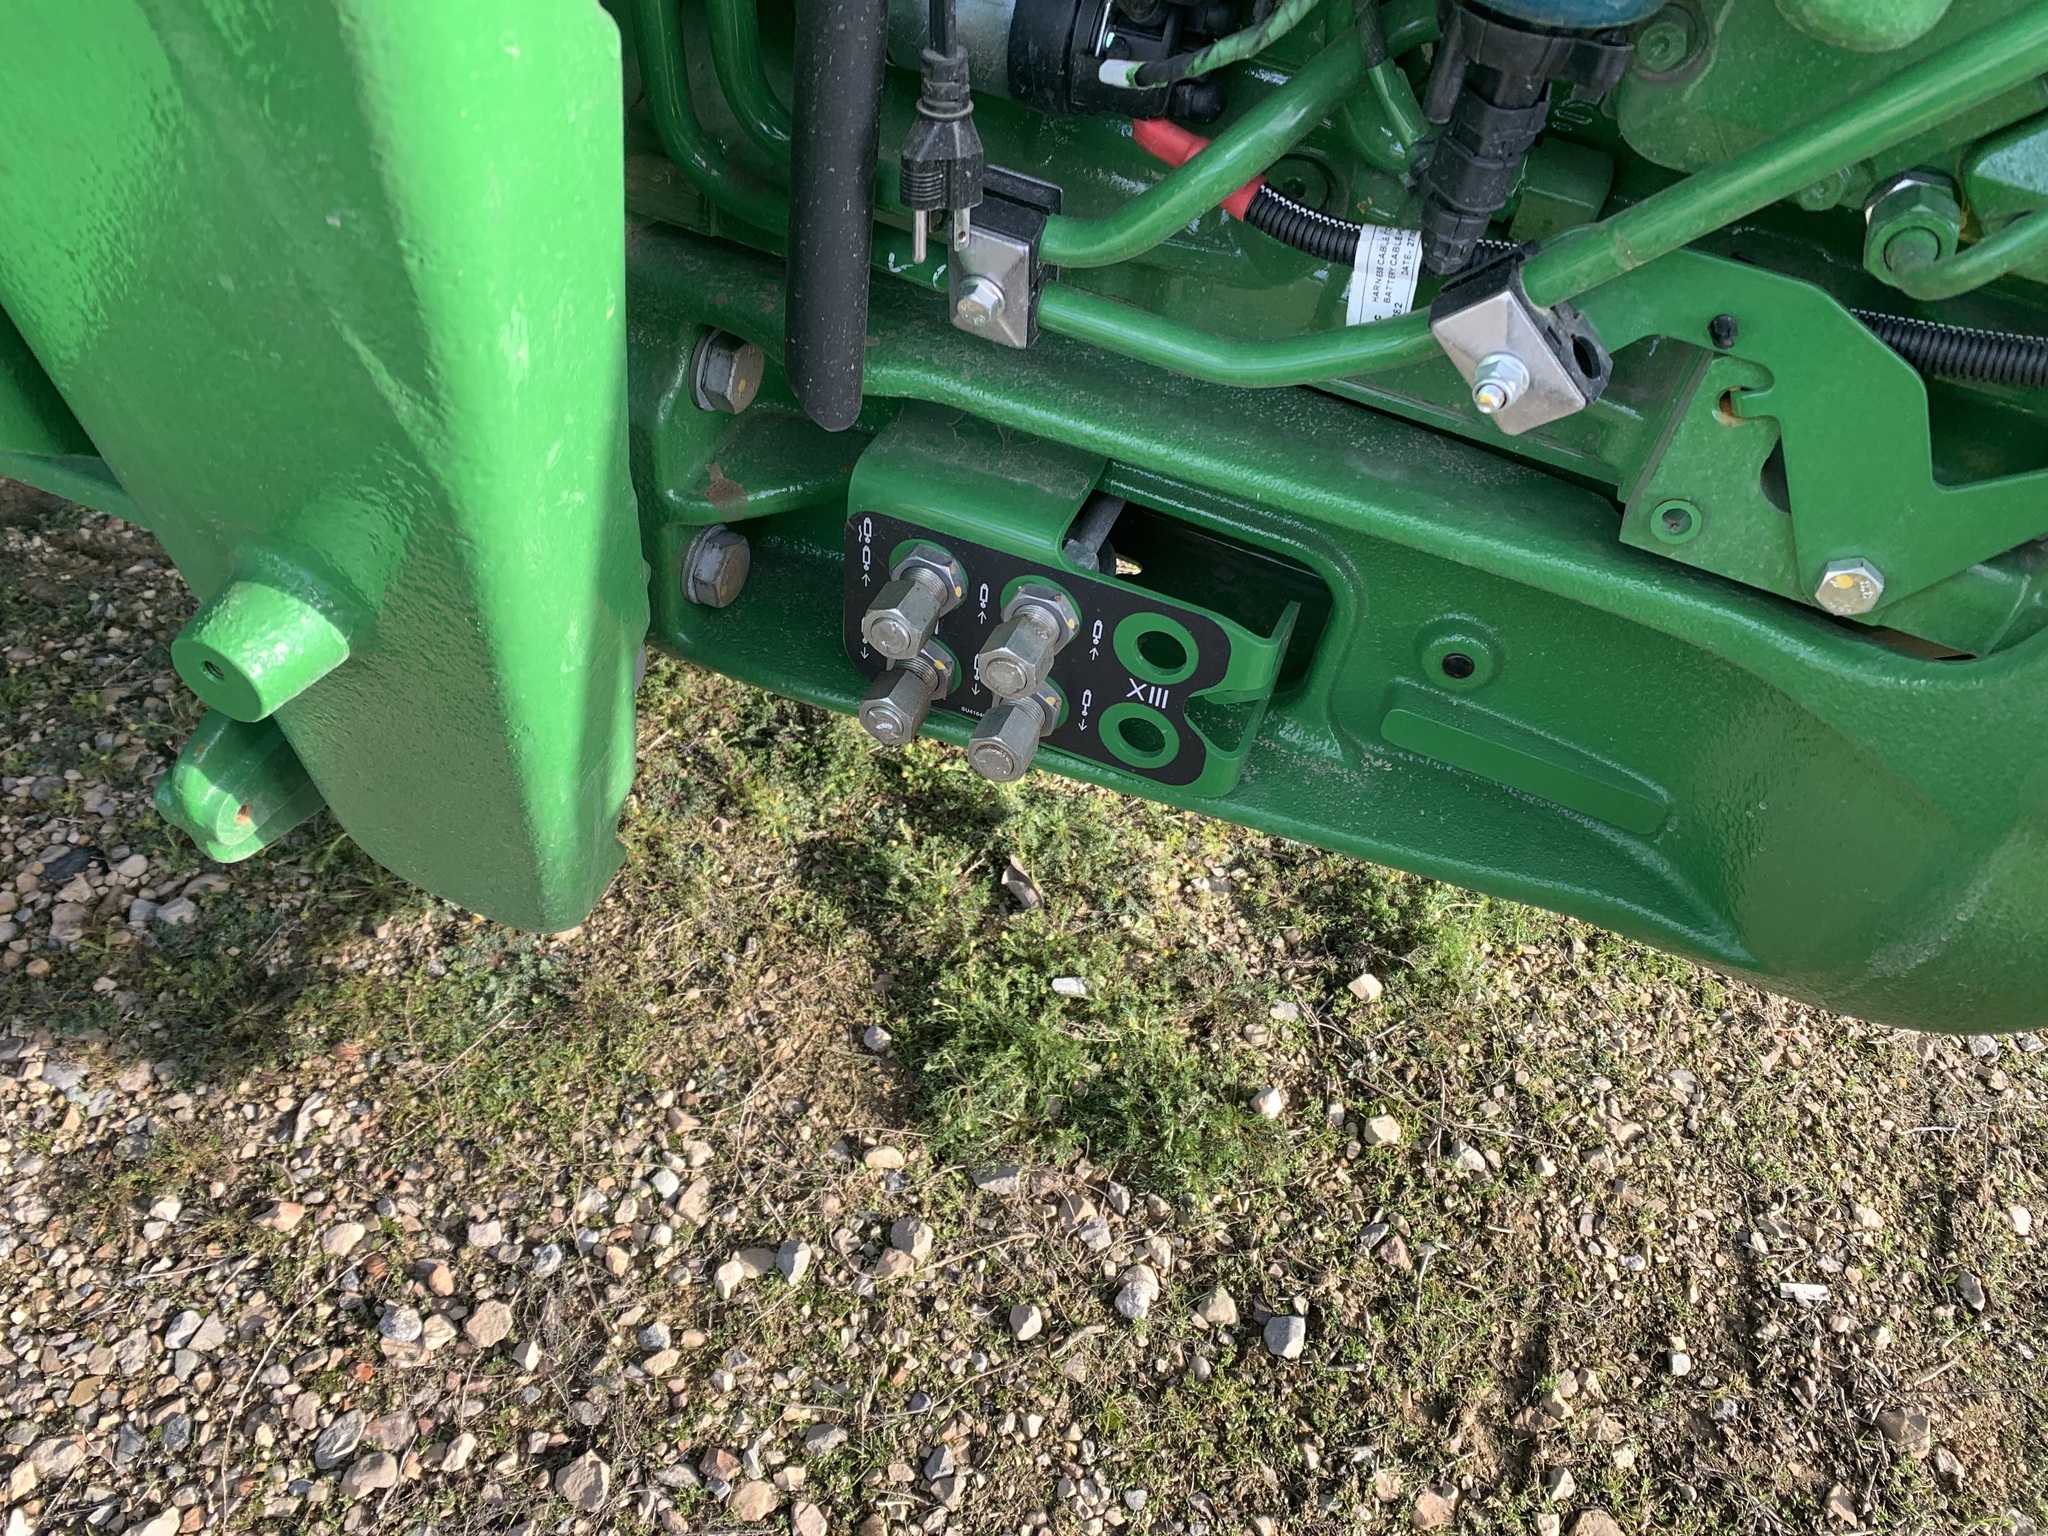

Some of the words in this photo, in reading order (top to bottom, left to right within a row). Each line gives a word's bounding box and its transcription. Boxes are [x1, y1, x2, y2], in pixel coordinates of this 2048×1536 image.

[1377, 236, 1390, 266] CABLE
[1372, 267, 1384, 303] HARNESS
[1383, 268, 1396, 304] BATTERY
[1125, 677, 1169, 709] XIII
[960, 706, 985, 718] SU4164
